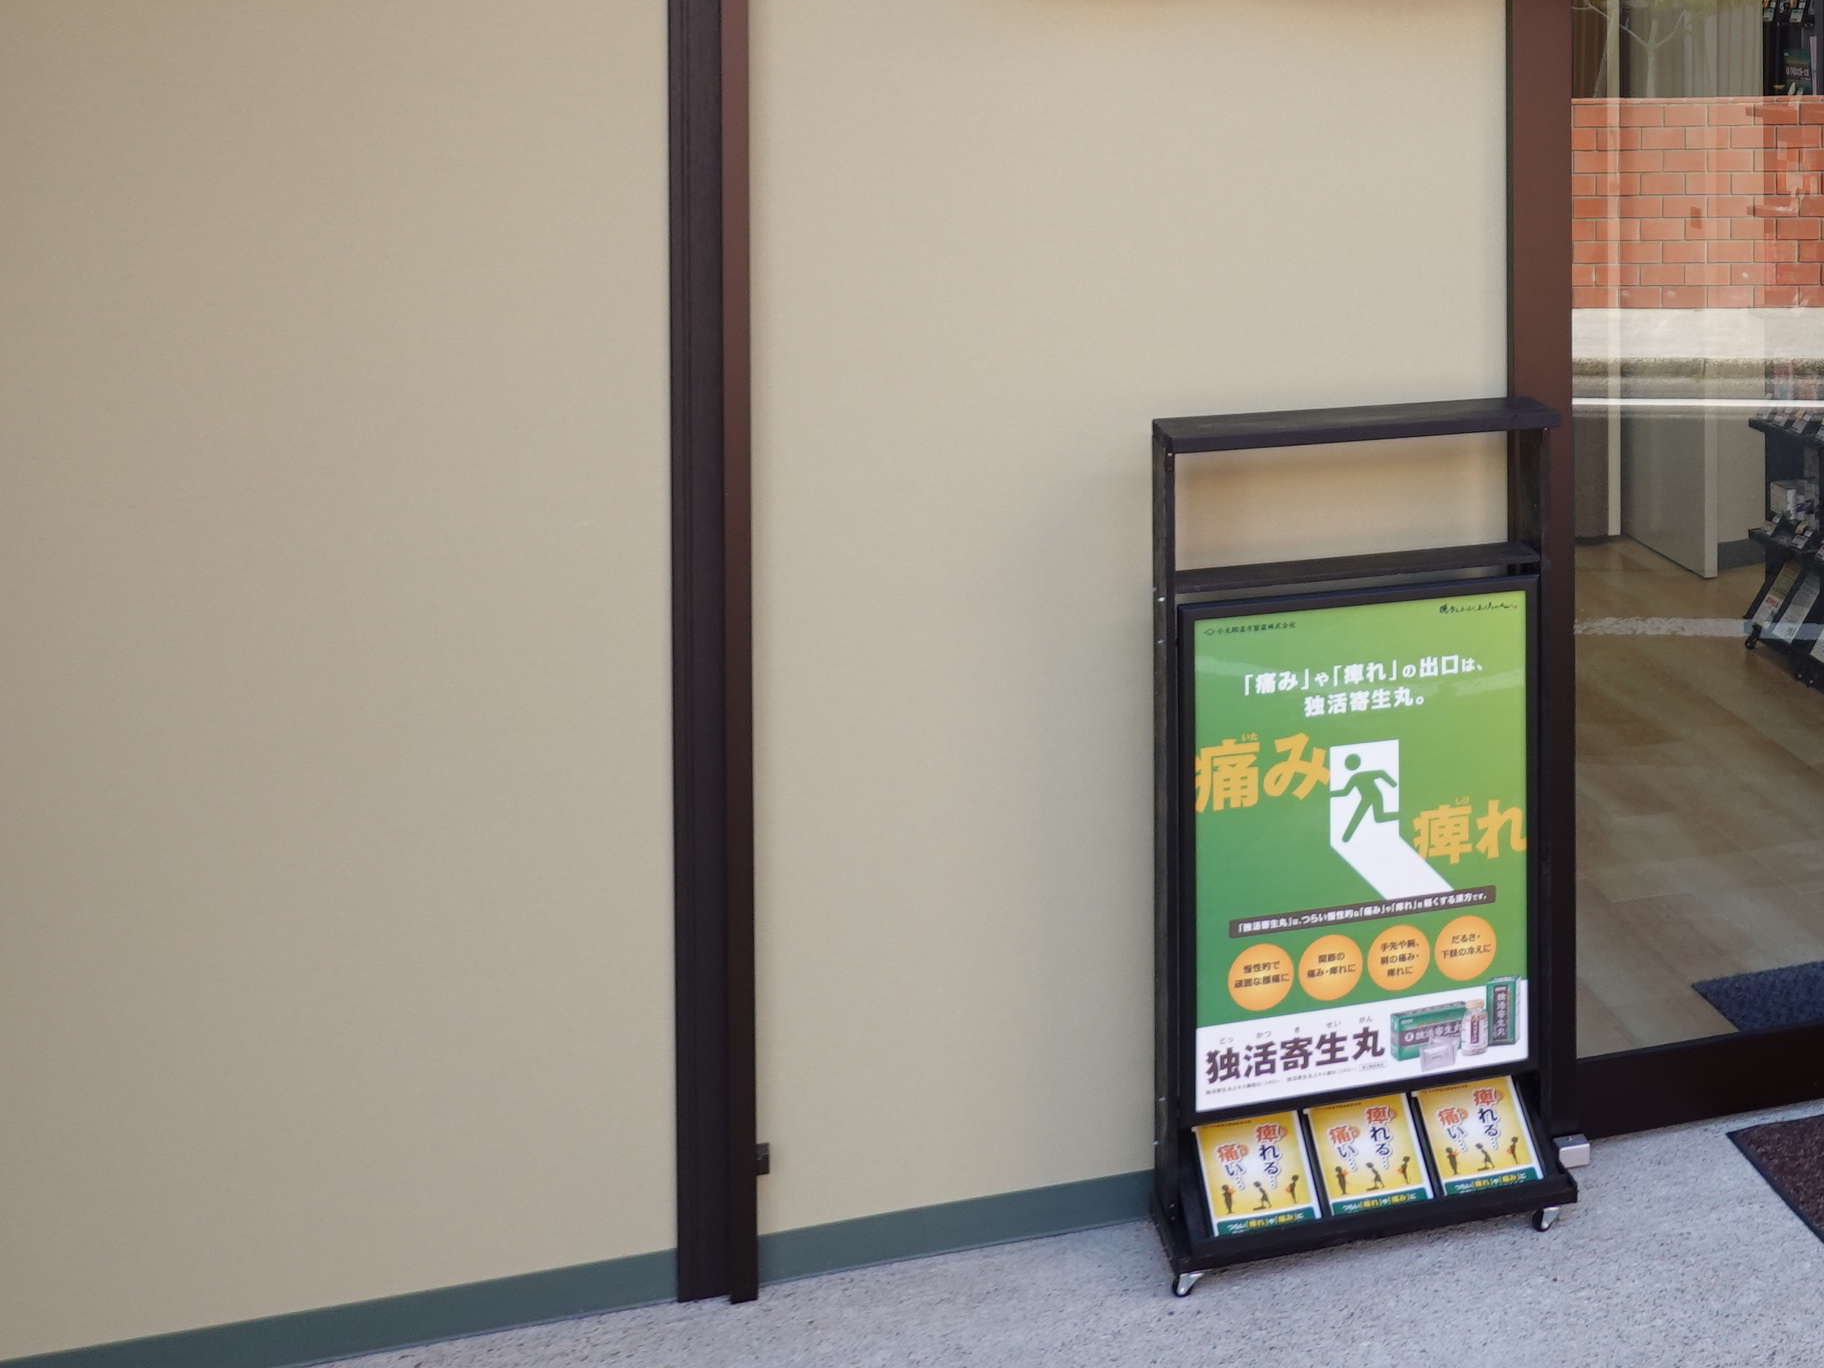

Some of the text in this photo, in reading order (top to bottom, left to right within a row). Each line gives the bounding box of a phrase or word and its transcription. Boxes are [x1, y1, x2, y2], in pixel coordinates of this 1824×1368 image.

[1195, 732, 1330, 814] 痛み
[1412, 799, 1527, 864] 痺れ
[1206, 1026, 1386, 1085] 独活寄生丸
